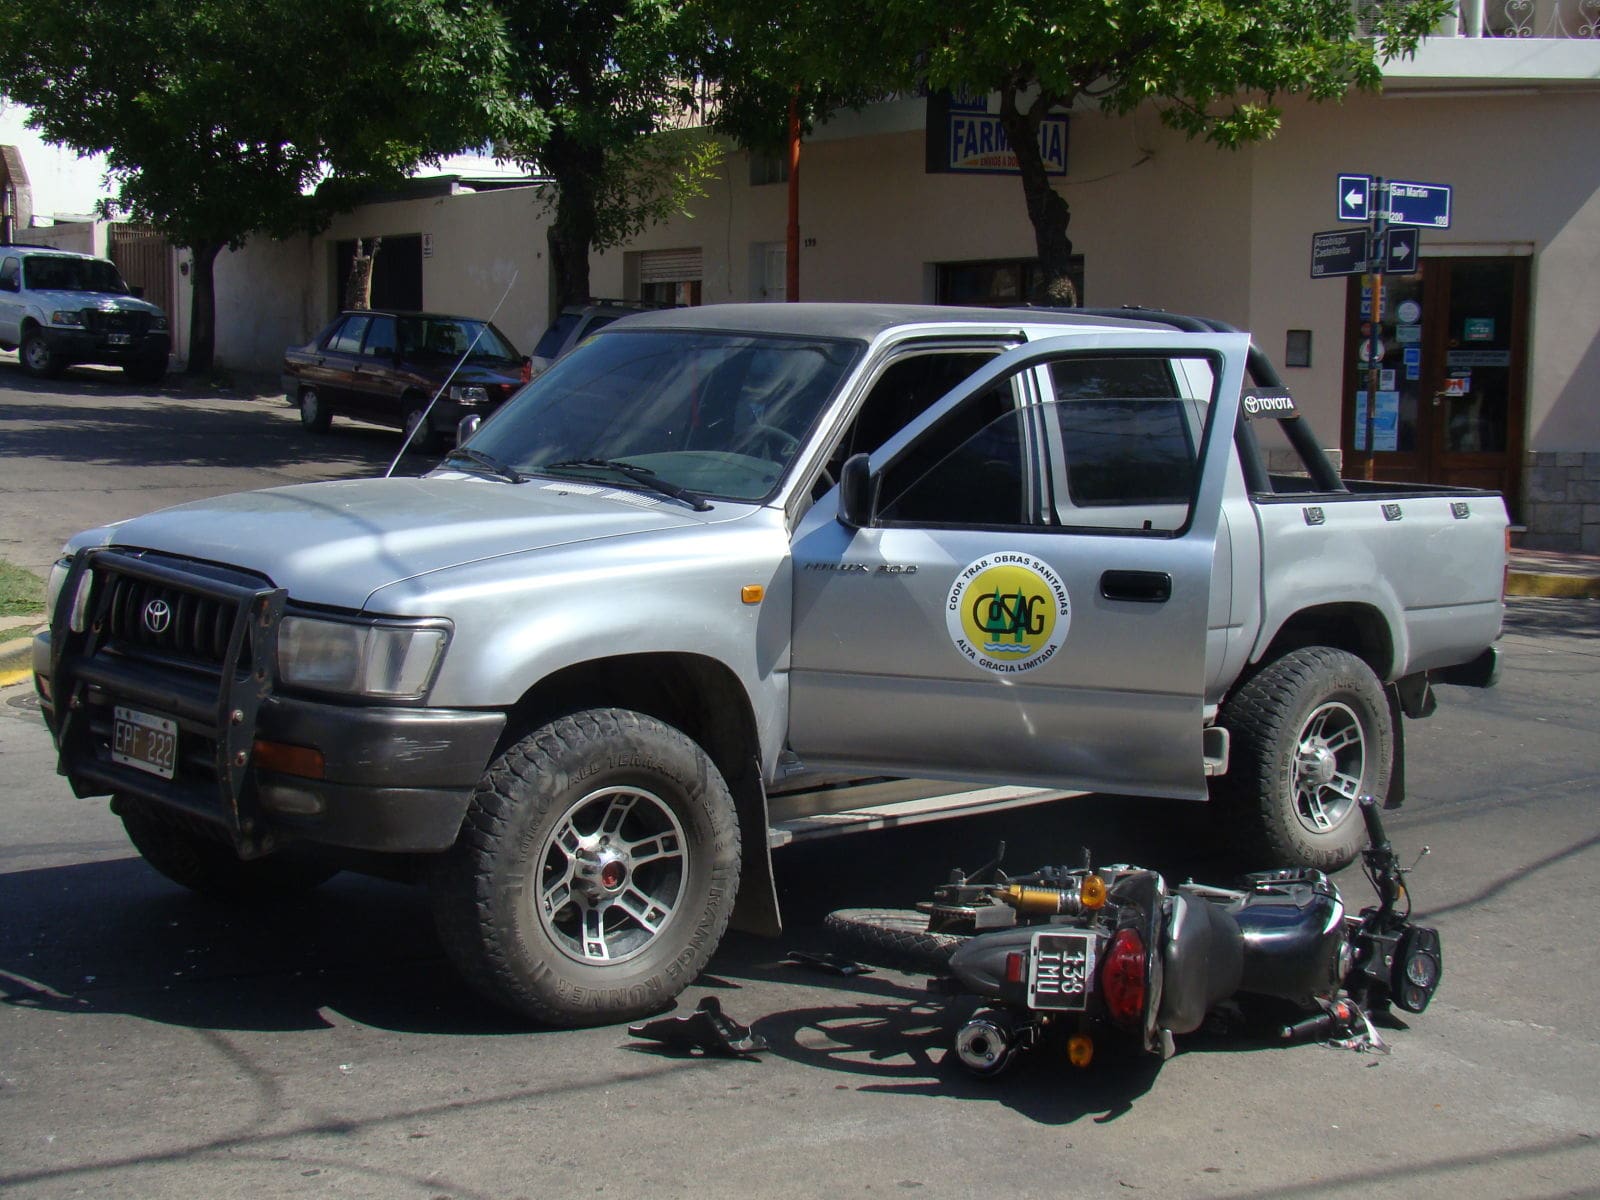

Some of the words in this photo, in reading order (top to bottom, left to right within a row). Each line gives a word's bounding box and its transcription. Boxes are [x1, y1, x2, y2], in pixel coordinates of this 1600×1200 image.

[953, 120, 1061, 167] FARMIA
[1391, 186, 1405, 197] San
[1391, 212, 1404, 222] 200
[1434, 215, 1447, 225] 100
[1257, 397, 1294, 410] TOYOTA
[949, 582, 965, 611] COOP.
[962, 560, 992, 580] TRAB.
[994, 555, 1030, 566] OBRAS
[1032, 561, 1068, 616] SANITARIAS
[957, 639, 976, 660] ALTA
[979, 658, 1016, 673] GRACIA
[1018, 644, 1058, 671] LIMITADA
[116, 721, 140, 755] EPF
[147, 731, 173, 766] 222
[665, 887, 724, 978] RANGE
[1037, 950, 1061, 993] IMU
[1061, 950, 1085, 994] 138
